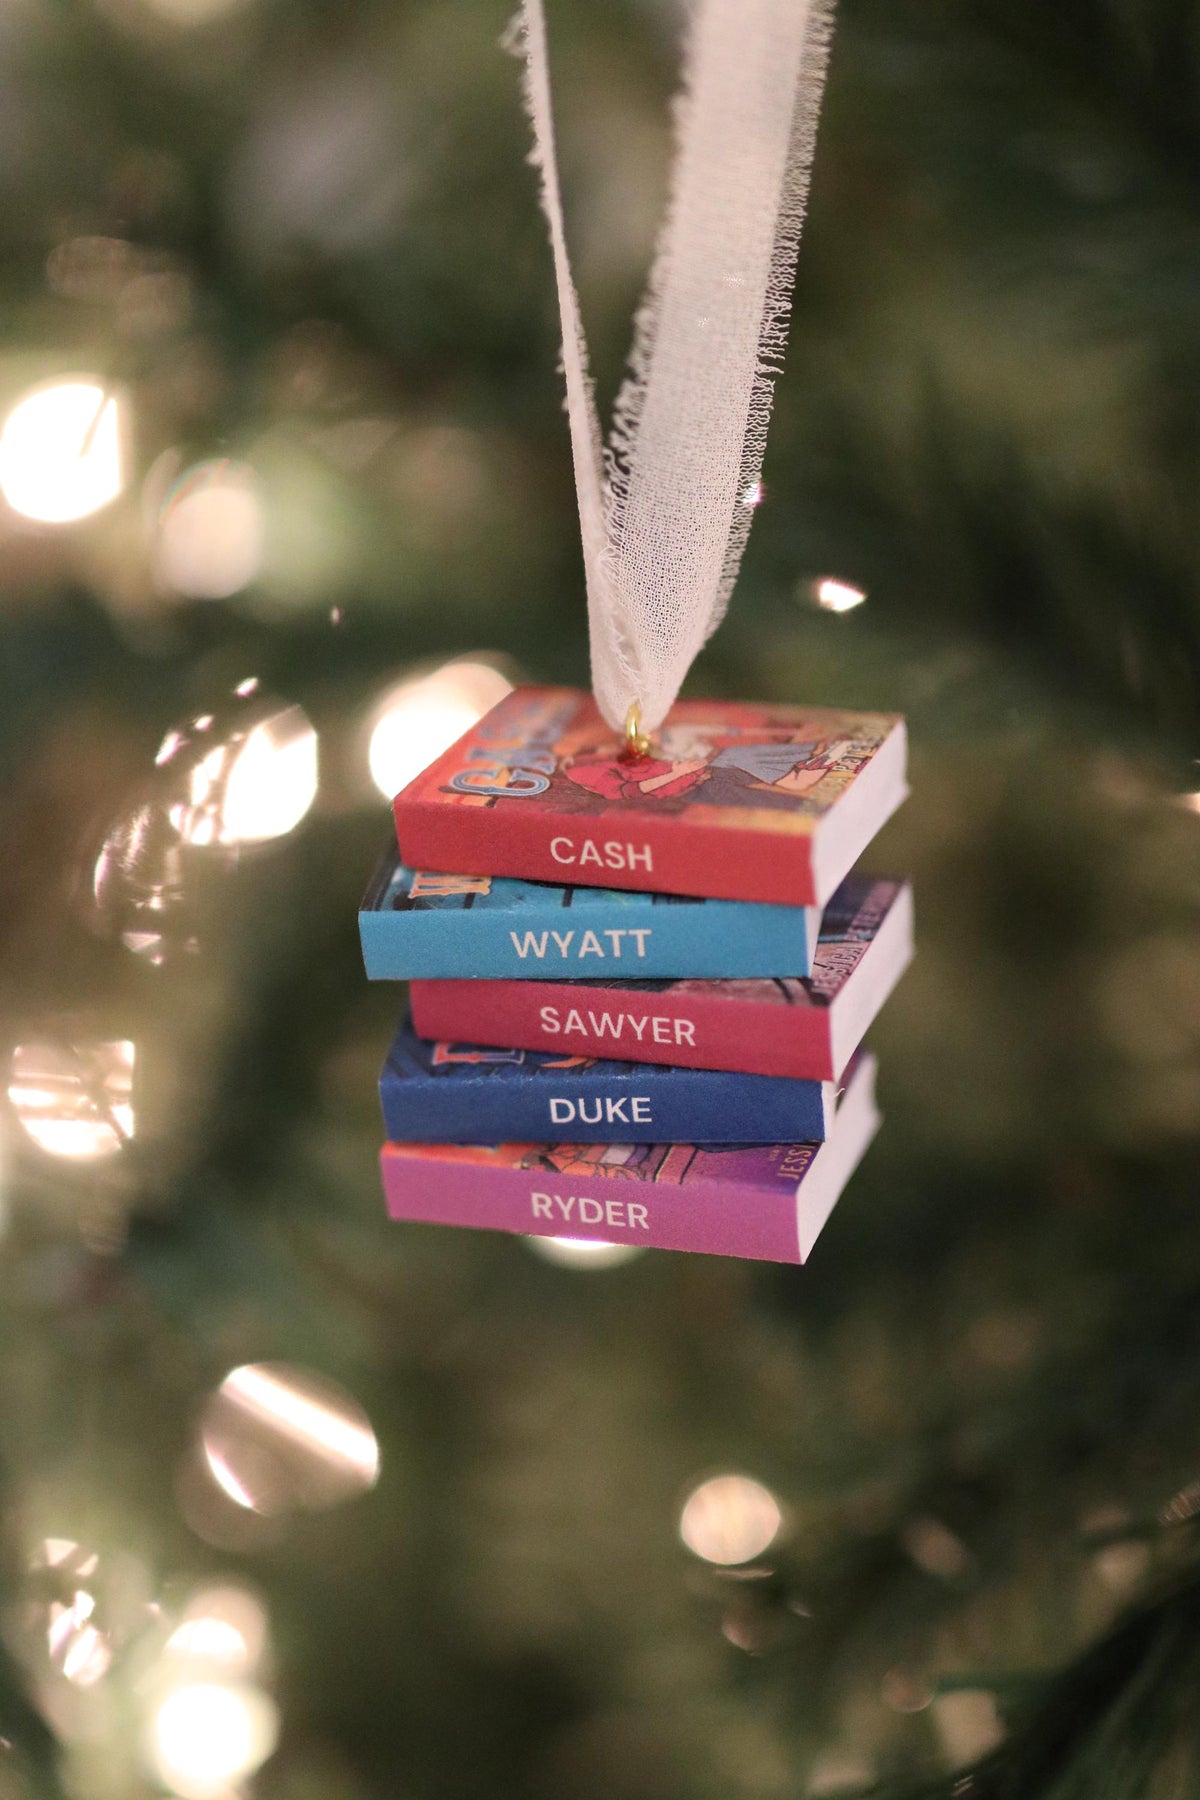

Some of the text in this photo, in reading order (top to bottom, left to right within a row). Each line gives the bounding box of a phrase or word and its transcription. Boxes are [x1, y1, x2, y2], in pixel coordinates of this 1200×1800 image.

[550, 836, 653, 872] CASH
[509, 928, 652, 959] WYATT
[540, 1006, 696, 1047] SAWYER
[549, 1097, 653, 1124] DUKE
[530, 1192, 650, 1230] RYDER
